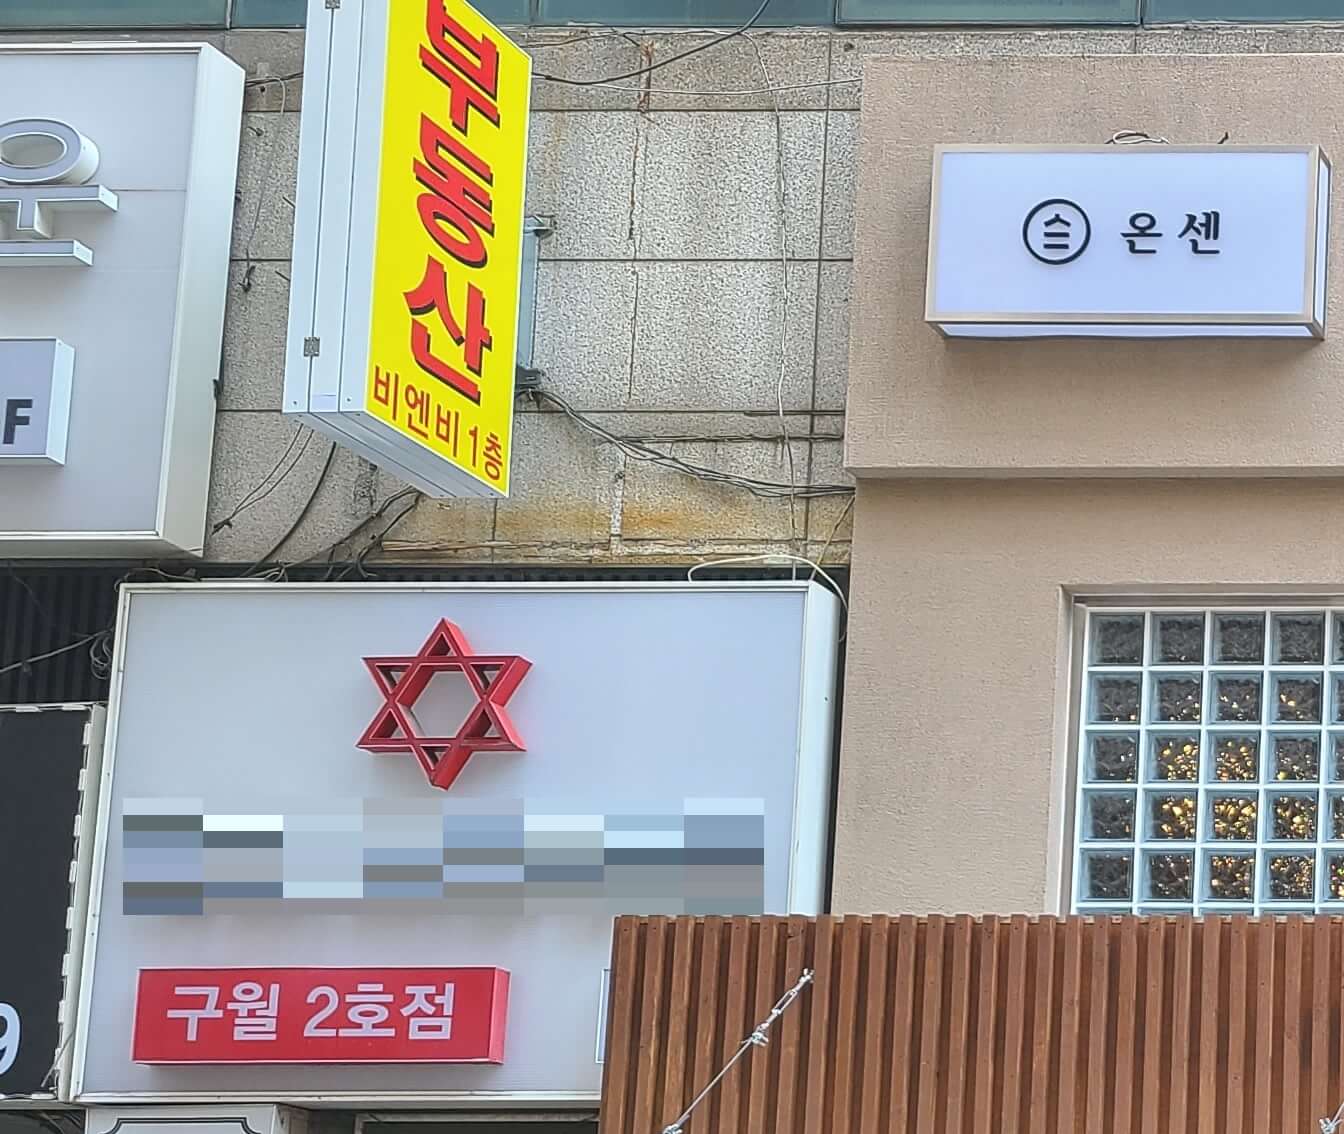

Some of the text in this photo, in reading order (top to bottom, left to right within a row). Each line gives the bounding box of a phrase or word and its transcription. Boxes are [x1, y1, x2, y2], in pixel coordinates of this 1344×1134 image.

[1121, 210, 1221, 255] 온센
[373, 366, 504, 482] 비엔비 1층
[166, 981, 456, 1043] 구월 2호점
